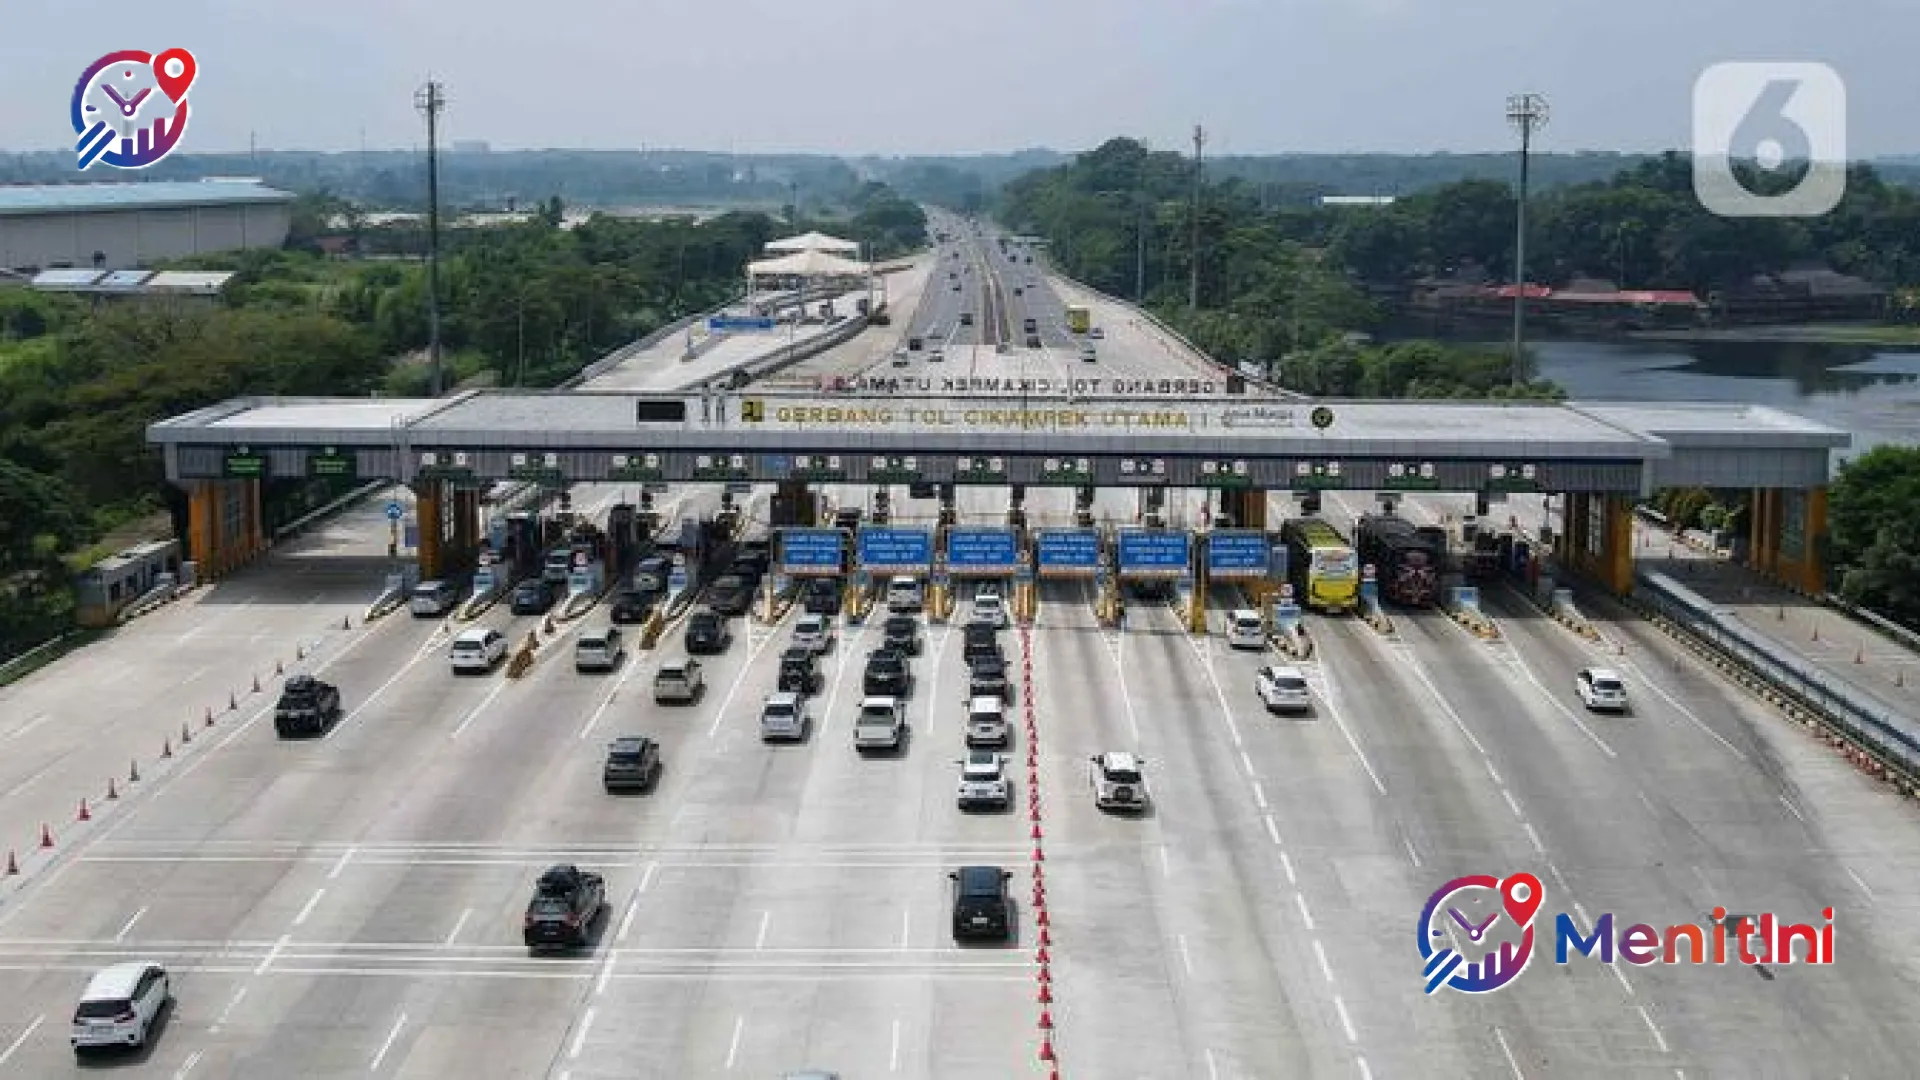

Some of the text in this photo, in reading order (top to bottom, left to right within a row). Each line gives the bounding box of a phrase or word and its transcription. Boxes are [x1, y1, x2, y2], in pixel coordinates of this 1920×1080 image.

[776, 406, 894, 424] GERBANG
[904, 409, 953, 425] TOL
[963, 409, 1088, 426] CIKAMPEK
[1103, 411, 1188, 428] UTAMA
